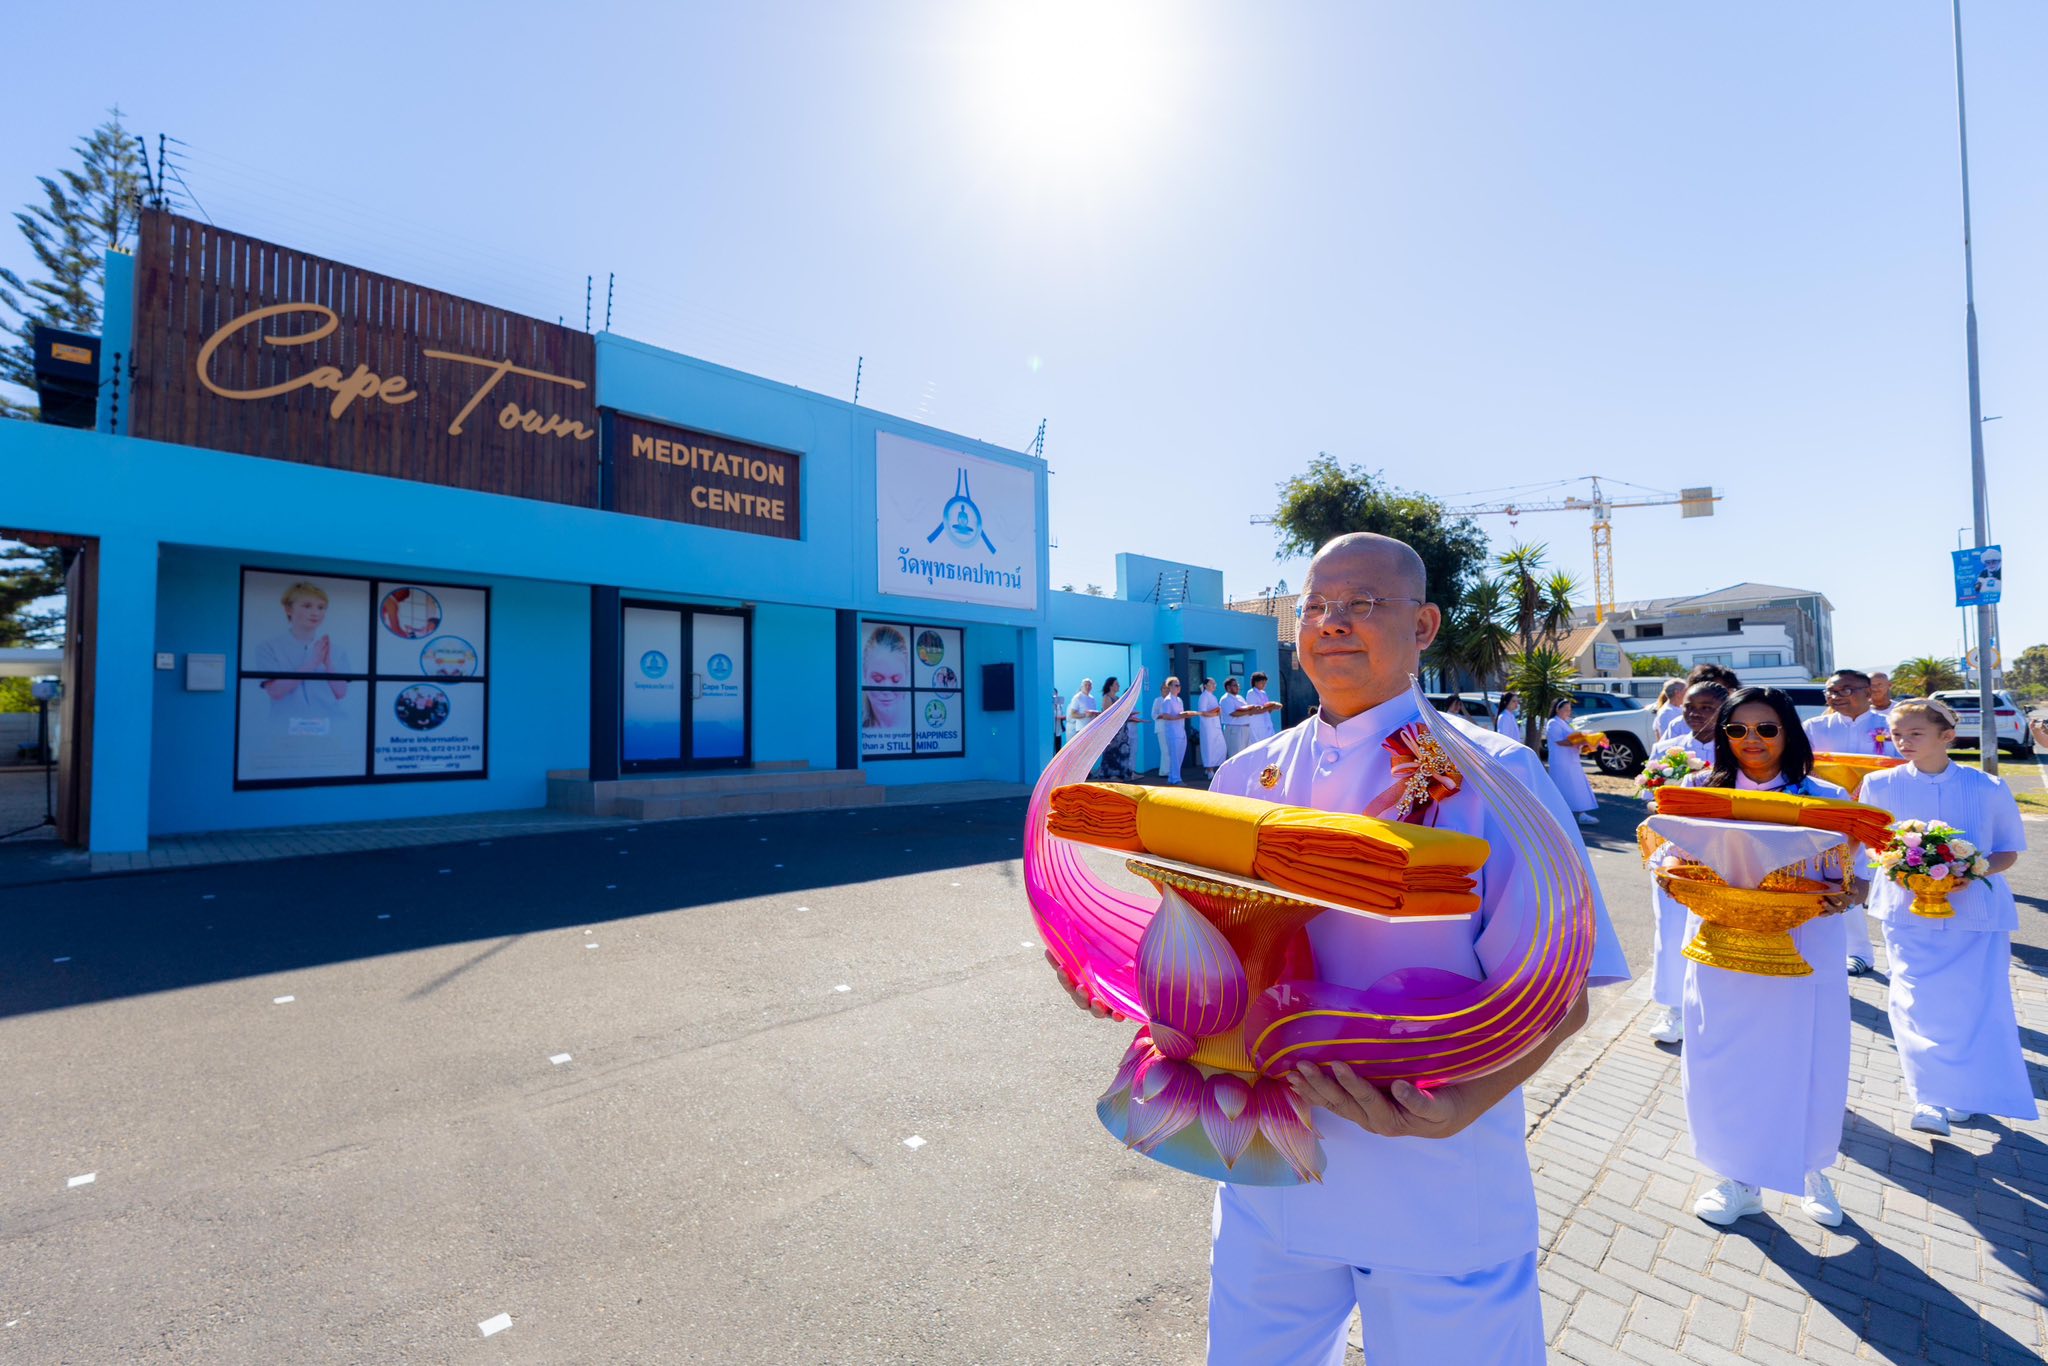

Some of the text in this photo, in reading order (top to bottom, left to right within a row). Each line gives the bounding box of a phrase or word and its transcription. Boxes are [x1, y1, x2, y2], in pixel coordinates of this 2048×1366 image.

[197, 302, 595, 441] Cape Town
[632, 433, 785, 486] MEDITATION
[690, 485, 785, 521] CENTRE
[897, 546, 1022, 589] วัดพุทธเคปทาวน์
[702, 683, 738, 691] Cape Town
[862, 742, 878, 750] than
[886, 741, 911, 751] STILL
[916, 731, 958, 739] HAPPINESS
